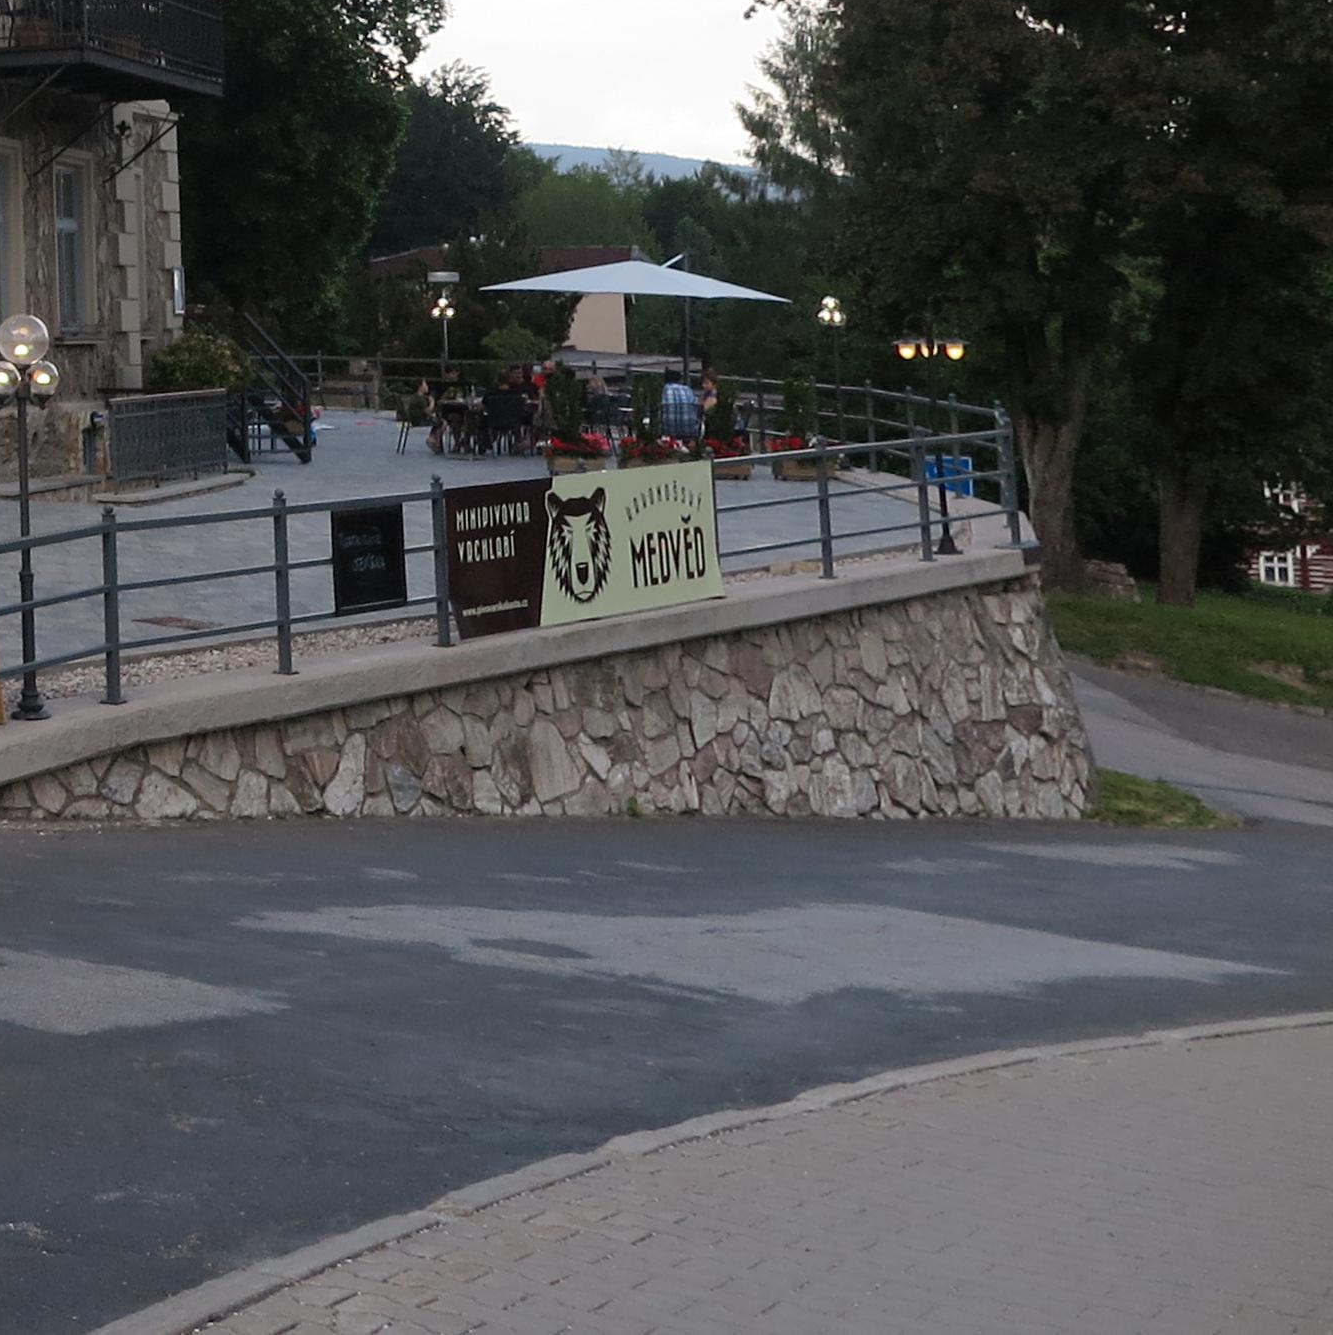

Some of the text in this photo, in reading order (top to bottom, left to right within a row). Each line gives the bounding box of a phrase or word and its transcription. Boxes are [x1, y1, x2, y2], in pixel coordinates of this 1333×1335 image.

[455, 500, 531, 533] MINIPIVOVAR
[457, 529, 516, 564] VRCHLABÍ
[628, 514, 707, 589] MEDVĚD
